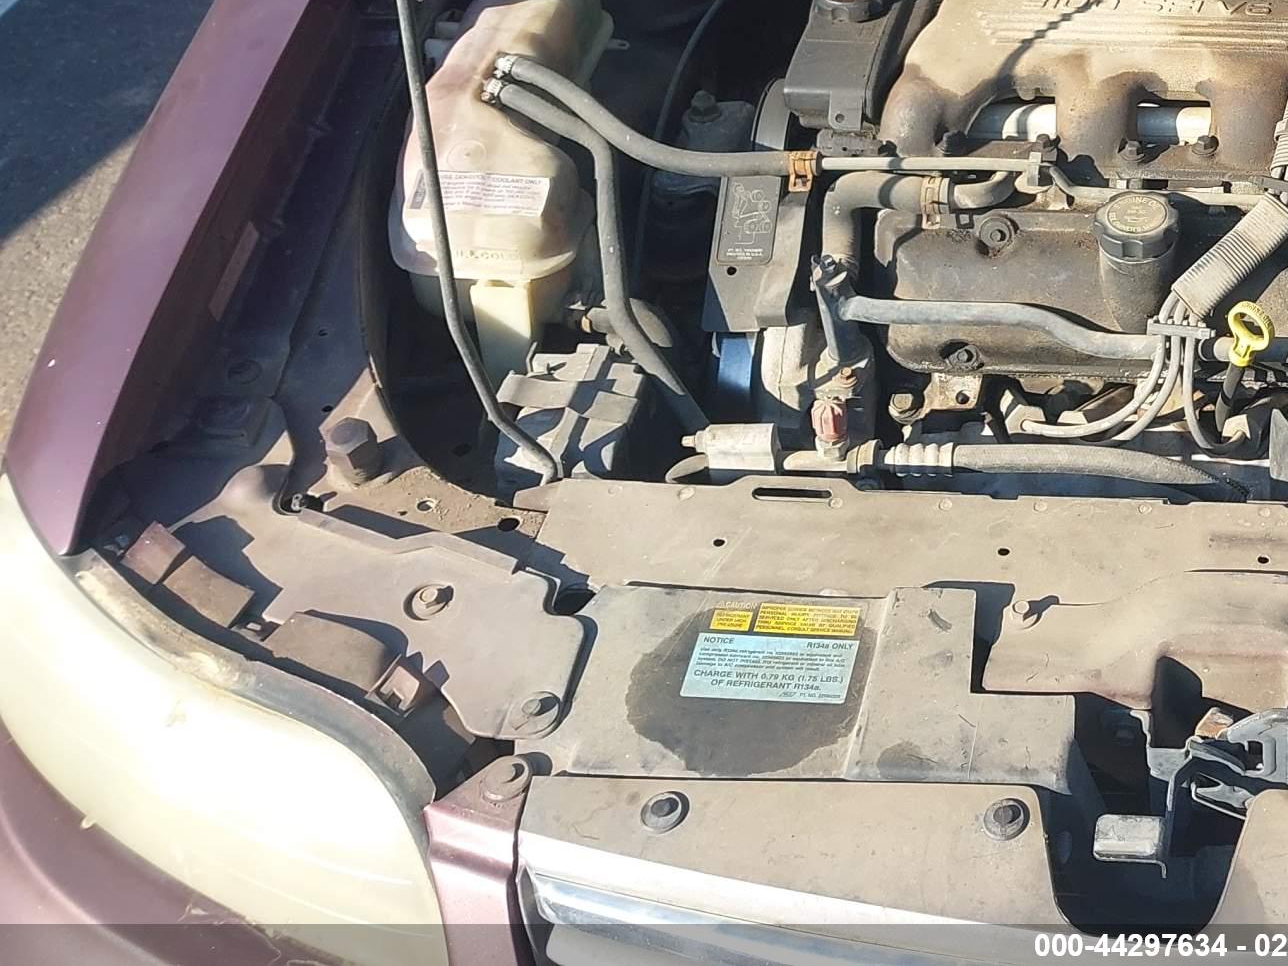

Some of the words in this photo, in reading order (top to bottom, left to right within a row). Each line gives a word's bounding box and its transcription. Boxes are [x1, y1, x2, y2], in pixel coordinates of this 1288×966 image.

[703, 636, 735, 644] NOTICE
[693, 669, 733, 678] CHARGE
[735, 671, 758, 680] WITH
[797, 674, 818, 683] (1.75
[726, 680, 792, 690] REFRIGERANT
